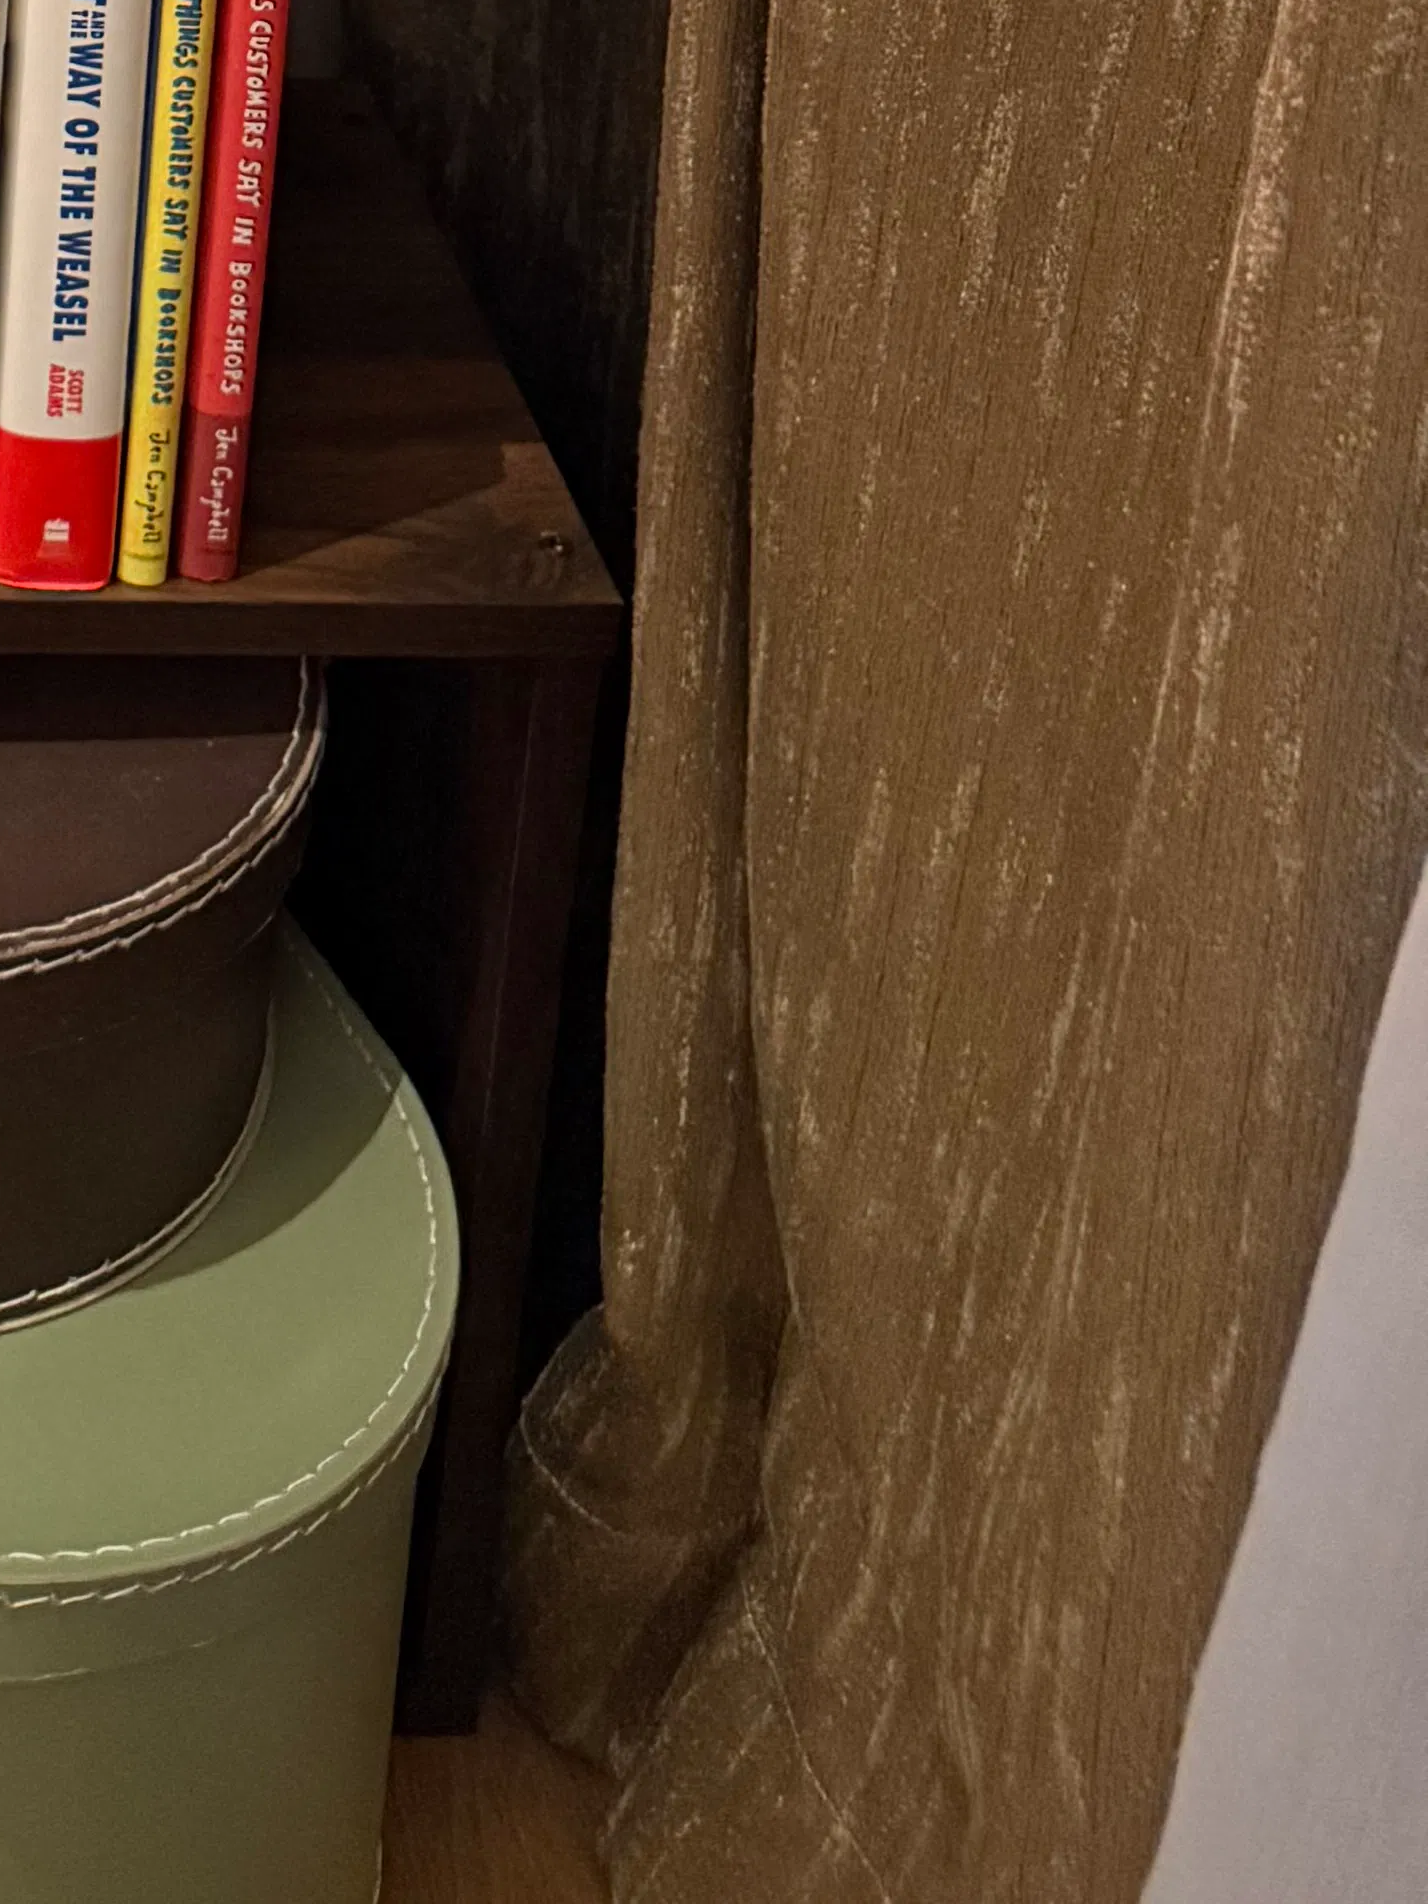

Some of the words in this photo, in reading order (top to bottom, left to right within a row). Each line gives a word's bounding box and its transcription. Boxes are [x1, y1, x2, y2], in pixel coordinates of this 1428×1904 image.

[65, 44, 104, 107] WAY
[63, 119, 100, 157] OF
[59, 167, 97, 223] THE
[52, 233, 94, 343] WEASEL
[47, 364, 66, 418] ADAMS
[67, 366, 86, 414] SCOTT
